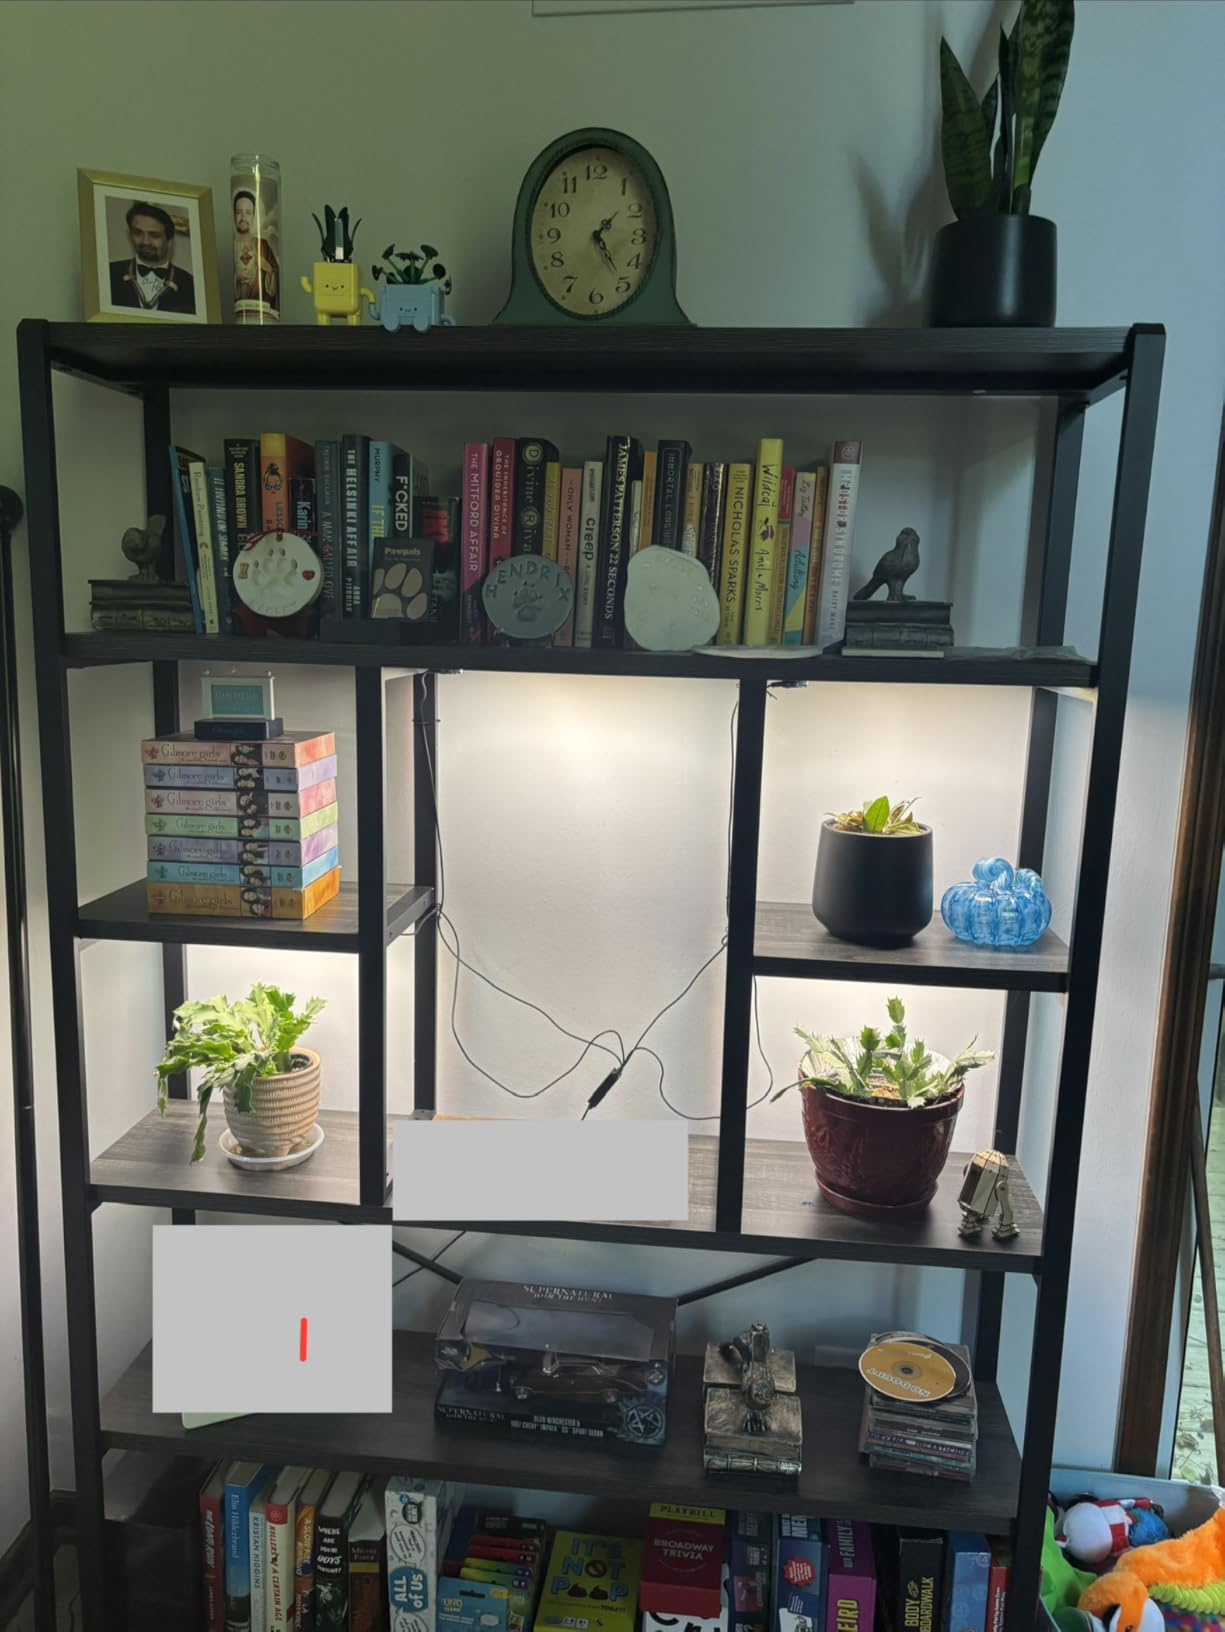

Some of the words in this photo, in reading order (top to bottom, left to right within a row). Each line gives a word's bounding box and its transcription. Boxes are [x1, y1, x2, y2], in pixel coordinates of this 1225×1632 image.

[562, 176, 577, 194] 11
[586, 165, 608, 180] 12
[620, 177, 627, 196] 1
[550, 202, 570, 218] 10
[628, 203, 643, 219] 2
[547, 228, 561, 244] 9
[631, 229, 647, 245] 3
[550, 252, 565, 268] 8
[626, 253, 641, 269] 4
[564, 275, 579, 294] 7
[588, 288, 604, 304] 6
[615, 277, 631, 293] 5
[347, 449, 356, 464] THE
[373, 447, 382, 483] MURPHY
[470, 453, 479, 469] THE
[616, 443, 629, 481] JAMES
[233, 463, 246, 496] SANDRA
[524, 445, 541, 504] Divine
[761, 464, 778, 509] Wildcat
[346, 468, 358, 523] HELSINKI
[469, 472, 481, 527] MITFORD
[566, 487, 575, 511] ONLY
[235, 497, 248, 529] BROWN
[275, 501, 286, 531] LESSO
[296, 501, 312, 531] Karin
[371, 504, 384, 518] IF
[609, 484, 623, 551] PATTERSON
[730, 487, 745, 555] NICHOLAS
[522, 510, 540, 553] Riva
[563, 515, 574, 551] WOMAN
[582, 517, 597, 561] creep
[345, 526, 358, 567] AFFAIR
[468, 531, 480, 572] AFFAIR
[609, 553, 619, 565] 22
[755, 548, 771, 577] Amelia
[790, 550, 806, 591] Adulting
[485, 561, 570, 600] HENDRIX
[604, 567, 617, 620] SECONDS
[726, 560, 740, 603] SPARKS
[754, 582, 768, 611] Morris
[161, 743, 198, 757] Gilmore
[199, 745, 221, 760] girls
[167, 793, 204, 806] Gilmore
[204, 794, 227, 809] girls
[523, 1285, 613, 1300] SUPERNATURAL
[909, 1386, 929, 1398] NO
[231, 1494, 240, 1510] Elin
[660, 1505, 715, 1518] PLAYBILL
[230, 1512, 240, 1559] Hilderbrand
[253, 1516, 261, 1551] KRISTAN
[269, 1525, 279, 1555] KILLERS
[303, 1525, 312, 1547] SLOW
[653, 1537, 715, 1553] BROADWAY
[837, 1523, 856, 1557] FAMILY
[317, 1555, 342, 1565] BOYS
[663, 1548, 704, 1561] TRIVIA
[253, 1553, 262, 1589] HIGGINS
[272, 1576, 281, 1606] CERTAIN
[394, 1576, 408, 1602] ALL
[409, 1590, 424, 1608] of
[274, 1607, 283, 1622] AGE
[836, 1599, 860, 1632] EIRD
[904, 1598, 920, 1627] BODY
